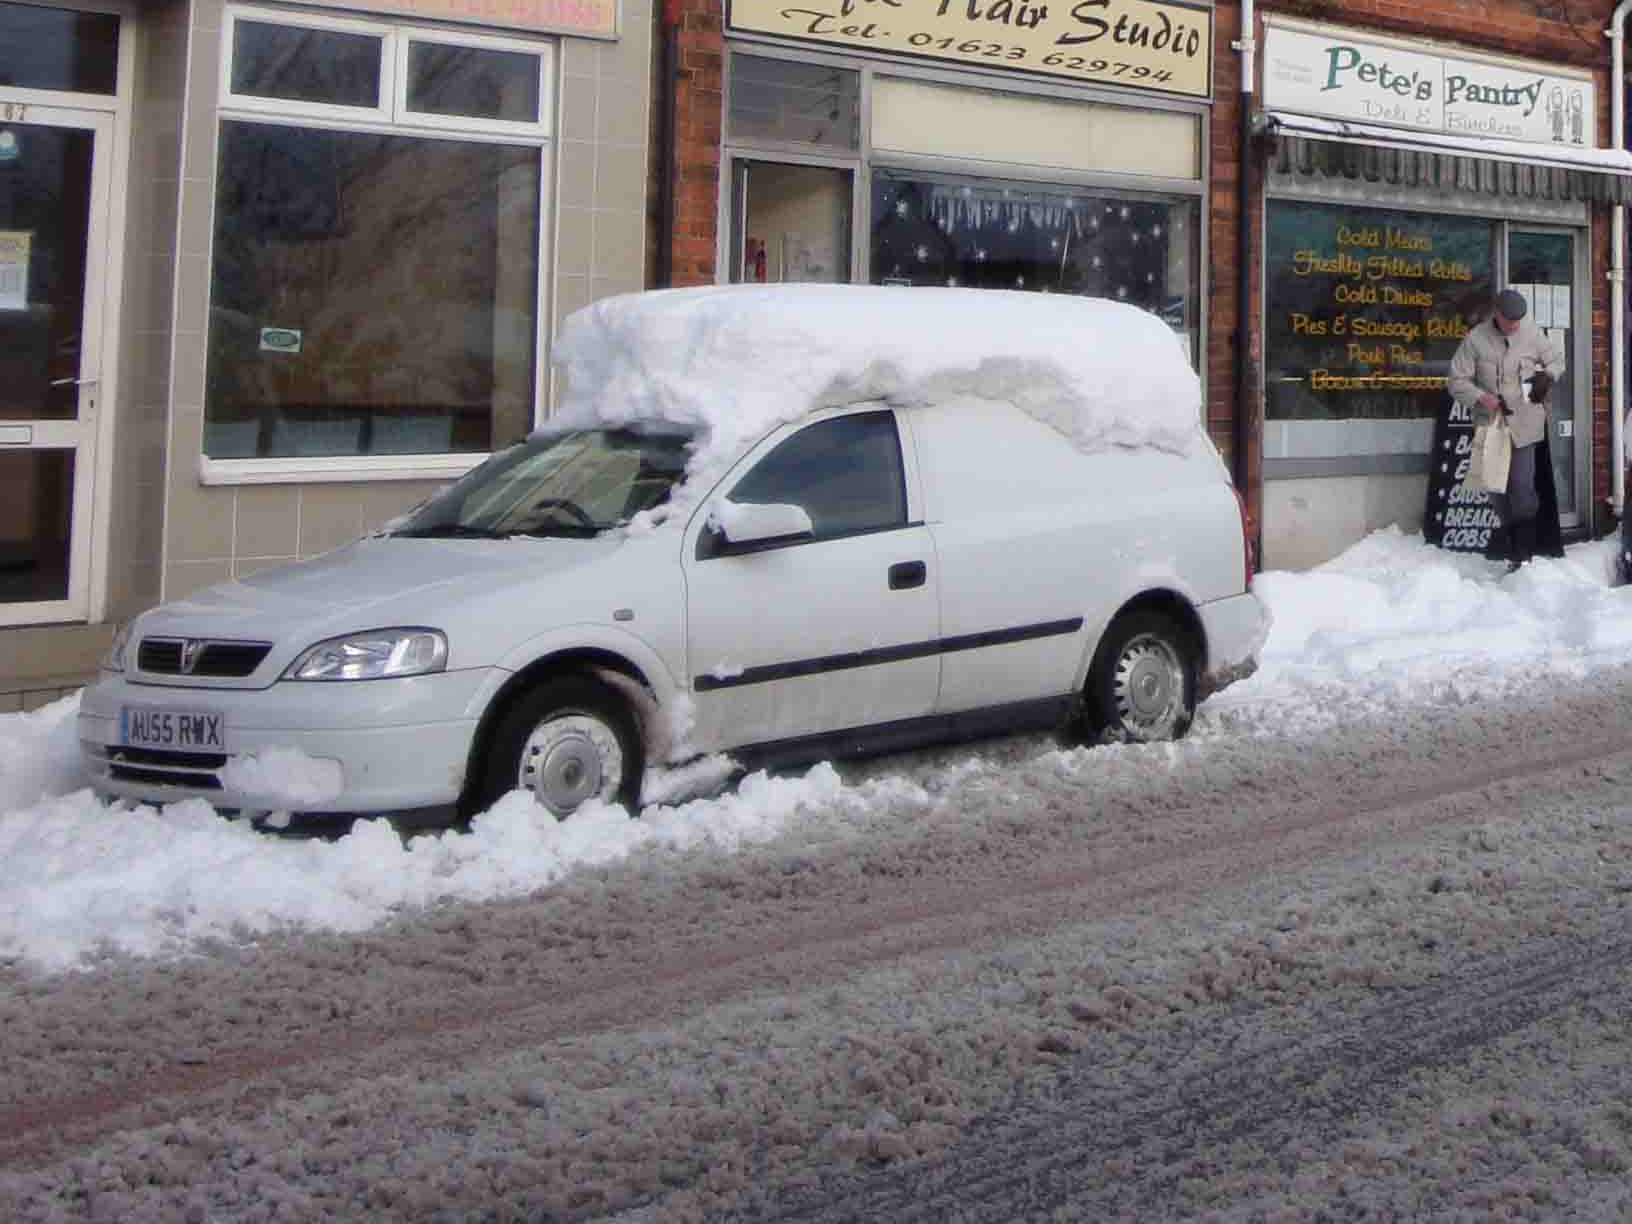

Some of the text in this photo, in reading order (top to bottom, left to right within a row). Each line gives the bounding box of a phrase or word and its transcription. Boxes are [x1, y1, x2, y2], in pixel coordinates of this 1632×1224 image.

[906, 31, 1028, 61] 01623
[1040, 51, 1174, 83] 629794
[1319, 45, 1433, 101] Pete's
[1445, 75, 1545, 118] Pantry
[1290, 313, 1329, 337] Pies
[1440, 527, 1493, 548] COBS
